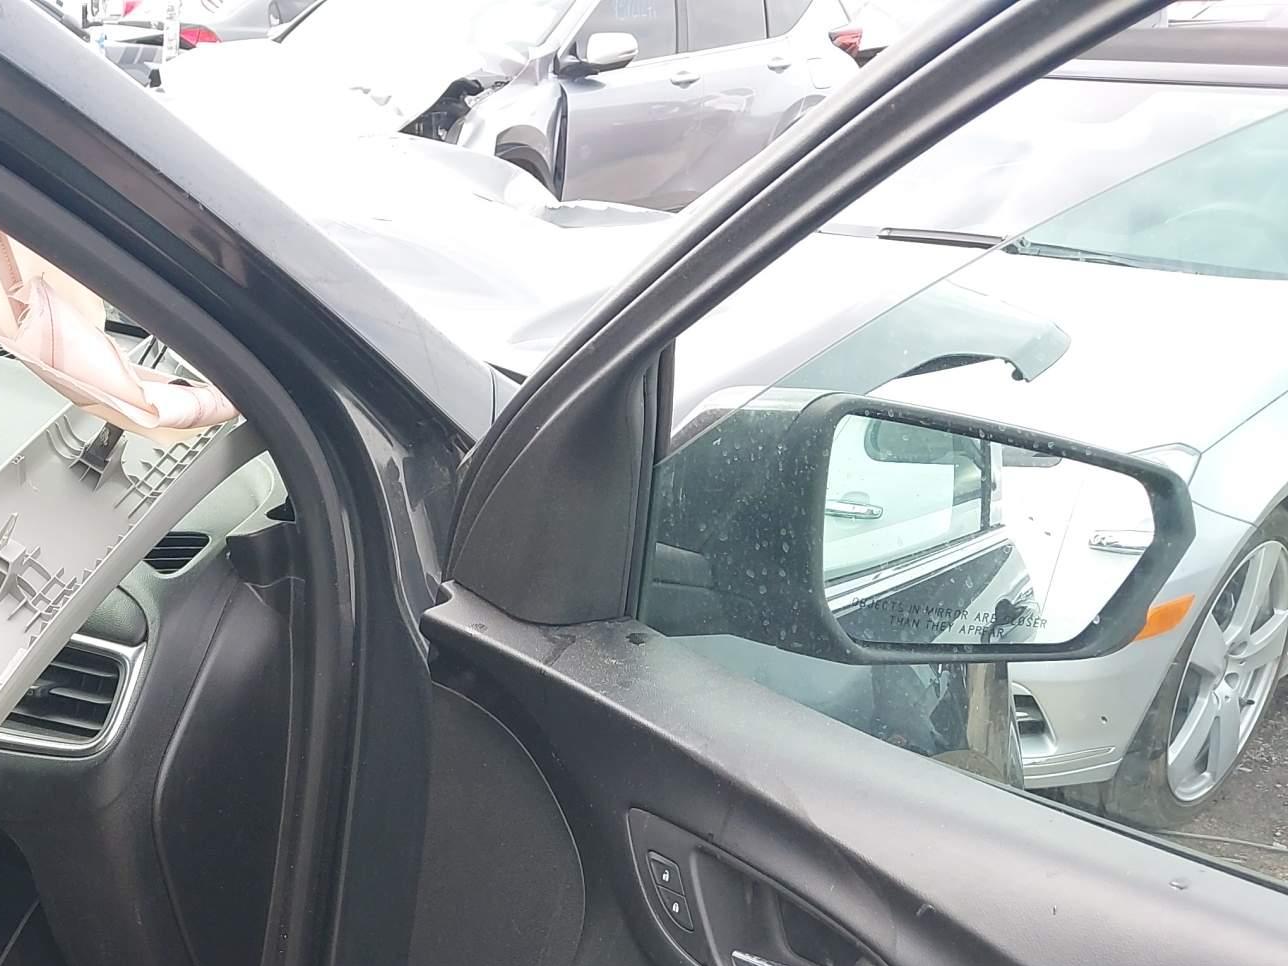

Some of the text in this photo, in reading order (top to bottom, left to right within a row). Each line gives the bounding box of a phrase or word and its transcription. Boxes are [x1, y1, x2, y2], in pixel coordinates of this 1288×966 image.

[852, 597, 904, 613] OBJECTS
[909, 604, 920, 614] IN
[923, 605, 969, 620] MIRROR
[890, 615, 1005, 638] THAN THEY APPEAR
